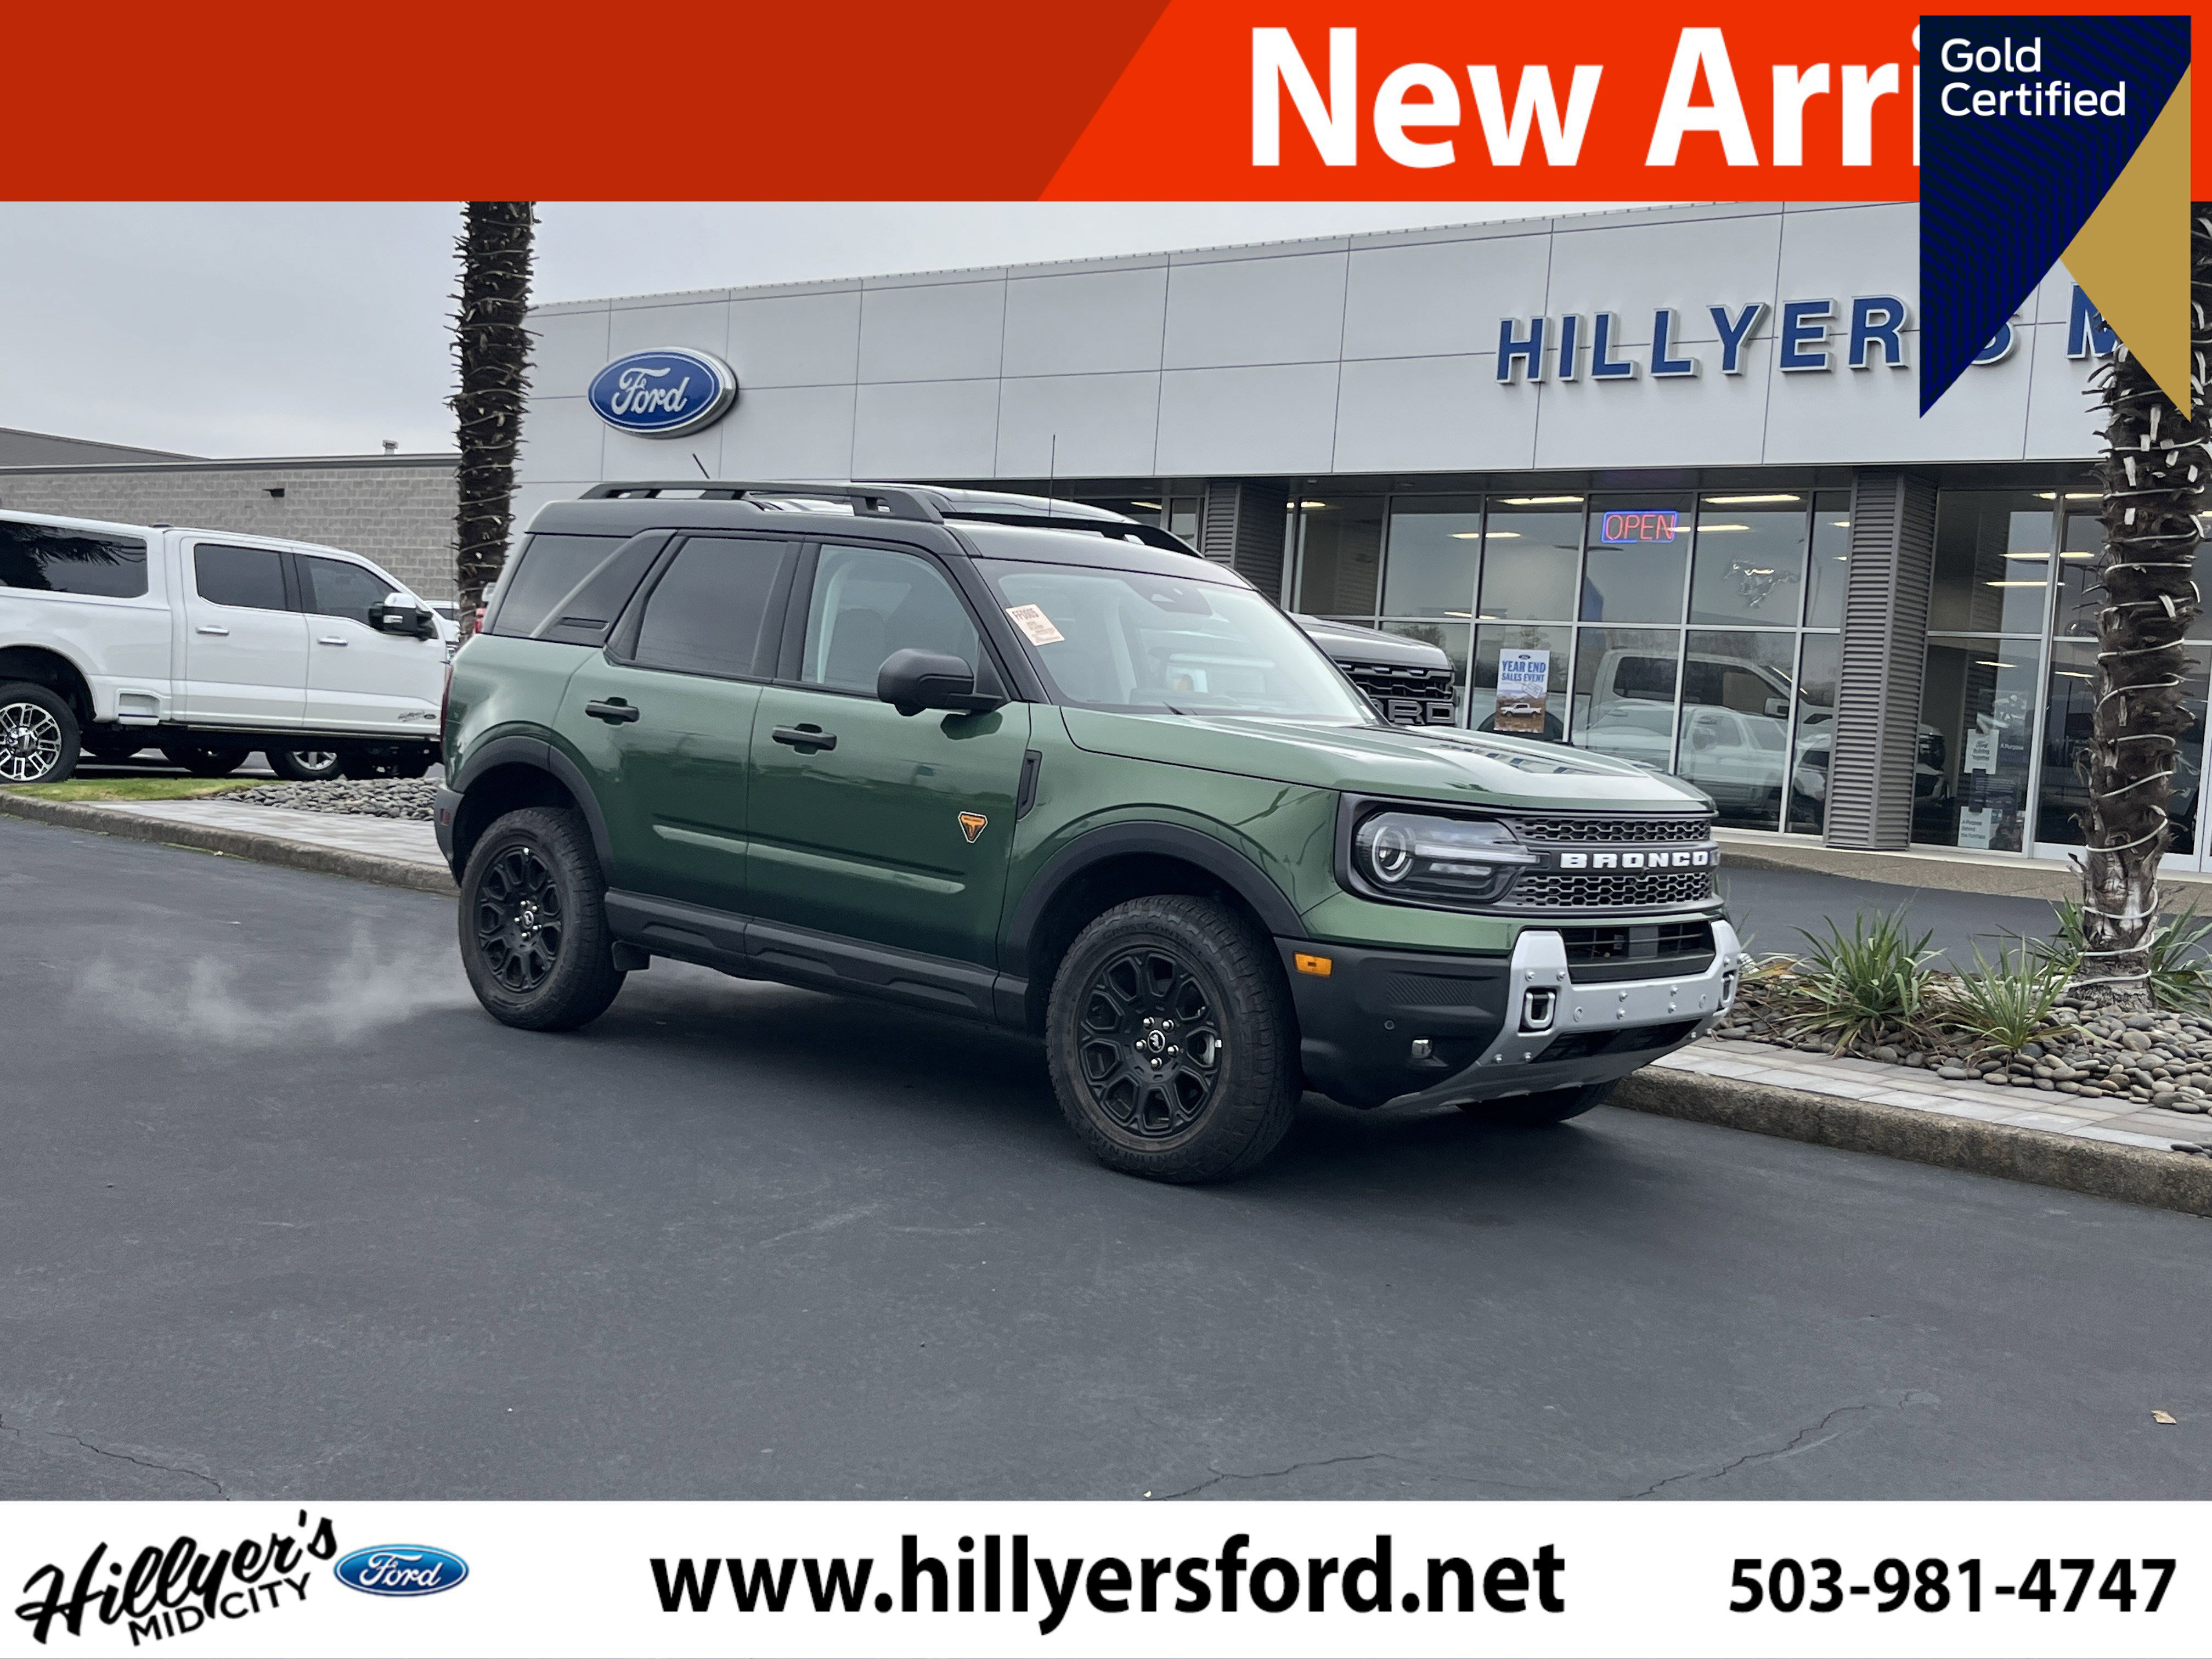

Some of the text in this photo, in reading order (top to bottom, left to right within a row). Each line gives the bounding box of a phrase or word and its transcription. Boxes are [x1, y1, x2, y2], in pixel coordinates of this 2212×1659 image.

[611, 367, 690, 415] Ford
[1605, 514, 1674, 540] OPEN
[1502, 661, 1546, 673] YEAR END
[1501, 673, 1545, 682] SALES EVENT
[1560, 851, 1708, 868] BRONCO
